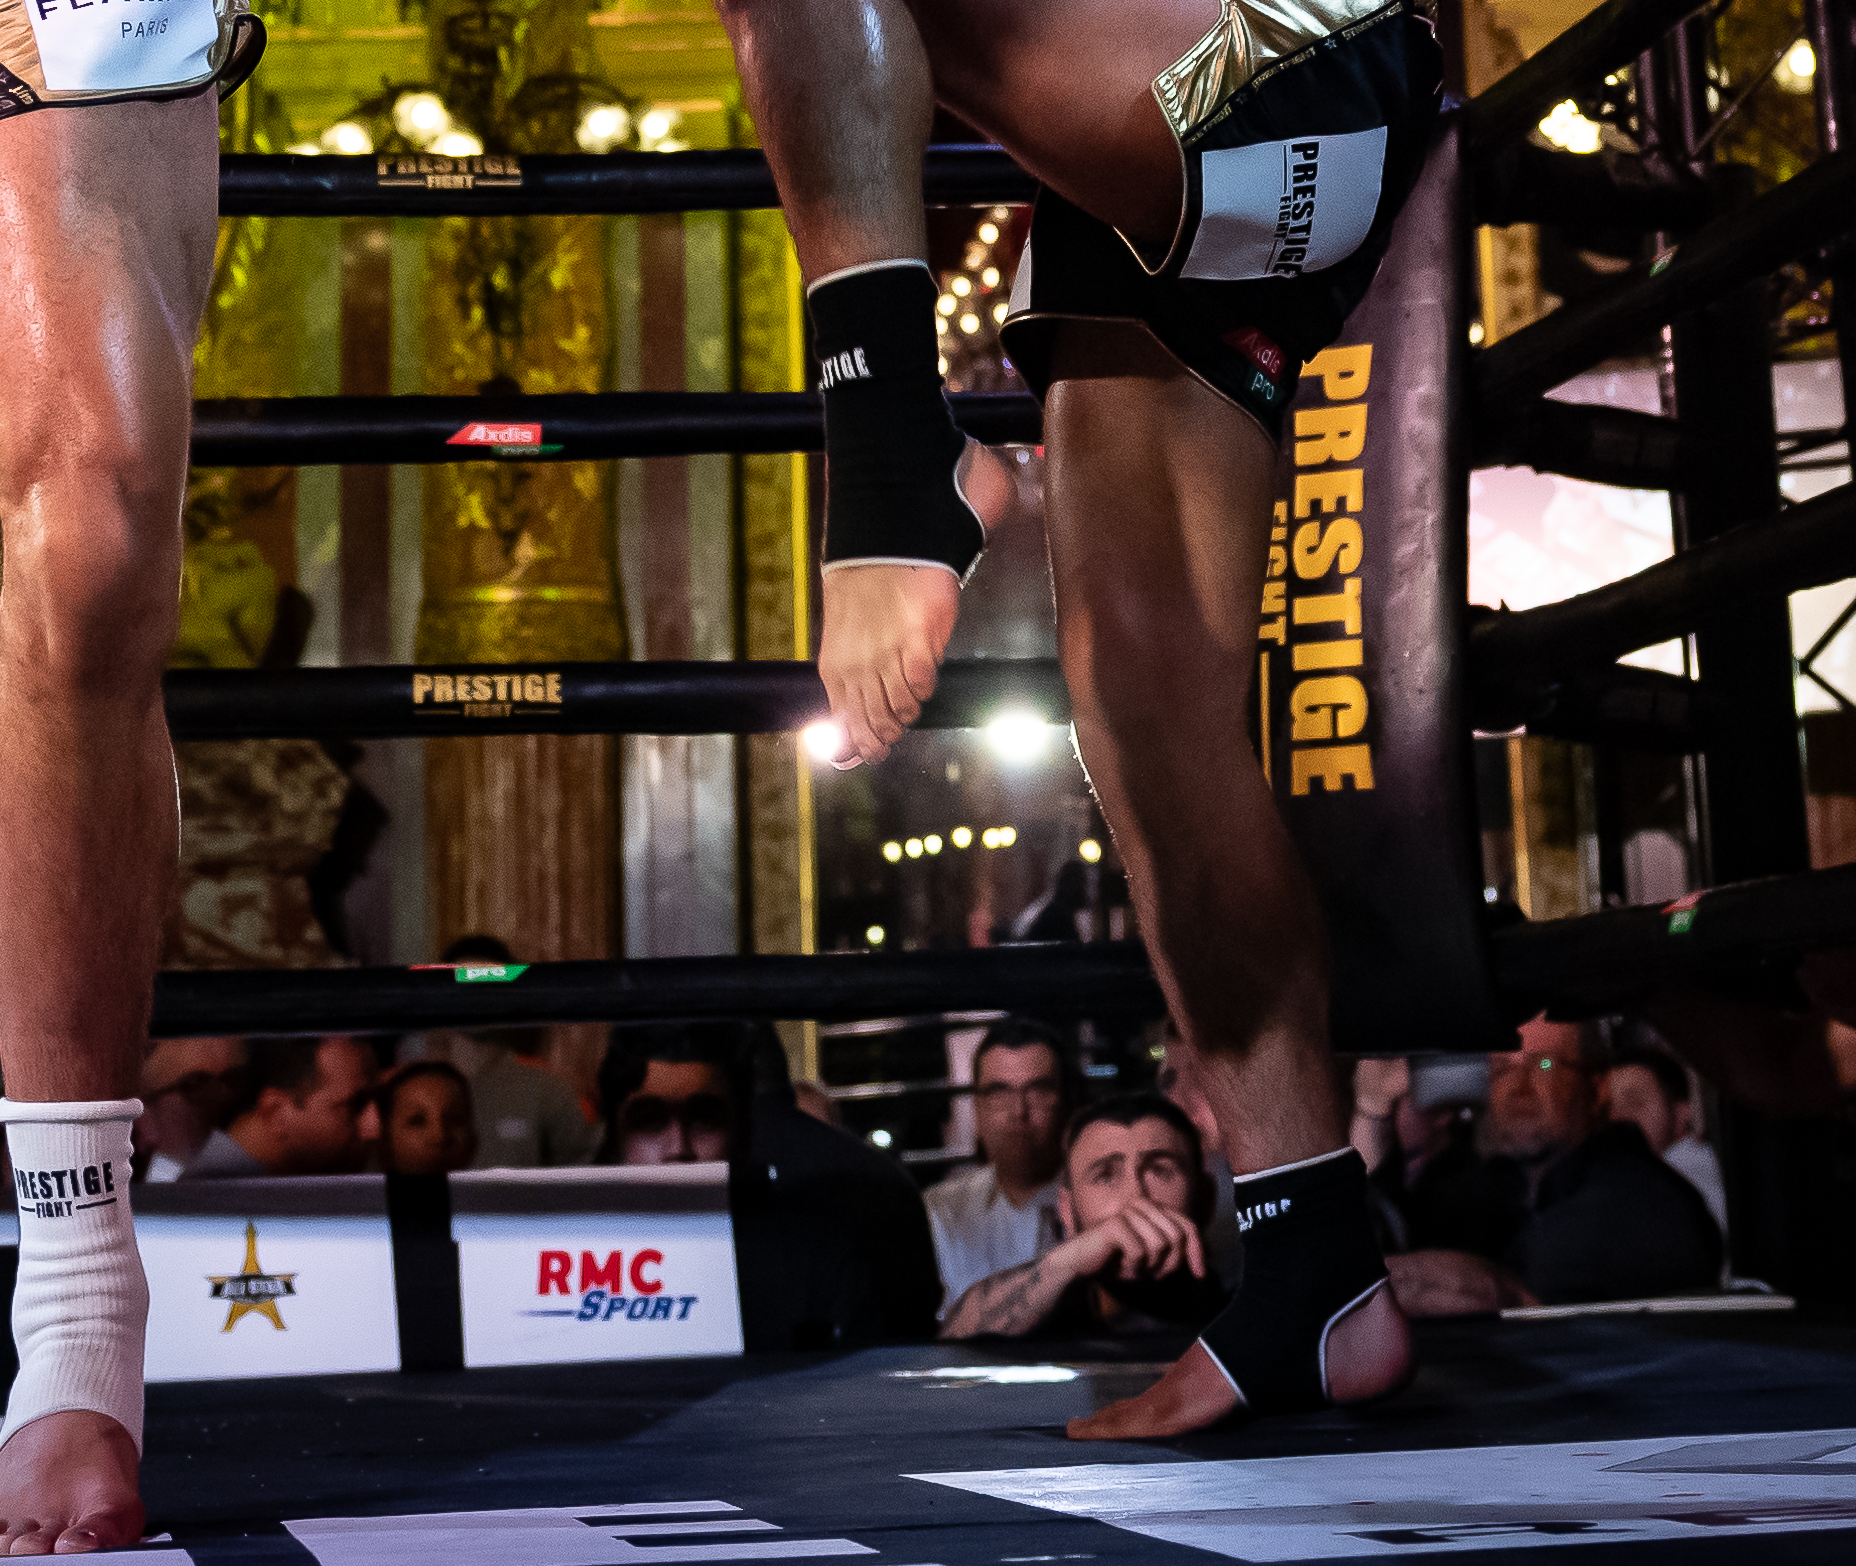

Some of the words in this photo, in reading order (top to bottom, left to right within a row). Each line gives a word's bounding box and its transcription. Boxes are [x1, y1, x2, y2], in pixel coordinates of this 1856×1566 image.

[121, 18, 168, 39] PARIS
[1272, 141, 1320, 276] PRESTIGE
[1275, 195, 1292, 239] FIGHT
[1251, 371, 1275, 400] pro
[1290, 343, 1376, 797] PRESTIGE
[412, 673, 562, 704] PRESTIGE
[538, 1248, 664, 1295] RMC
[578, 1291, 698, 1321] SPORT
